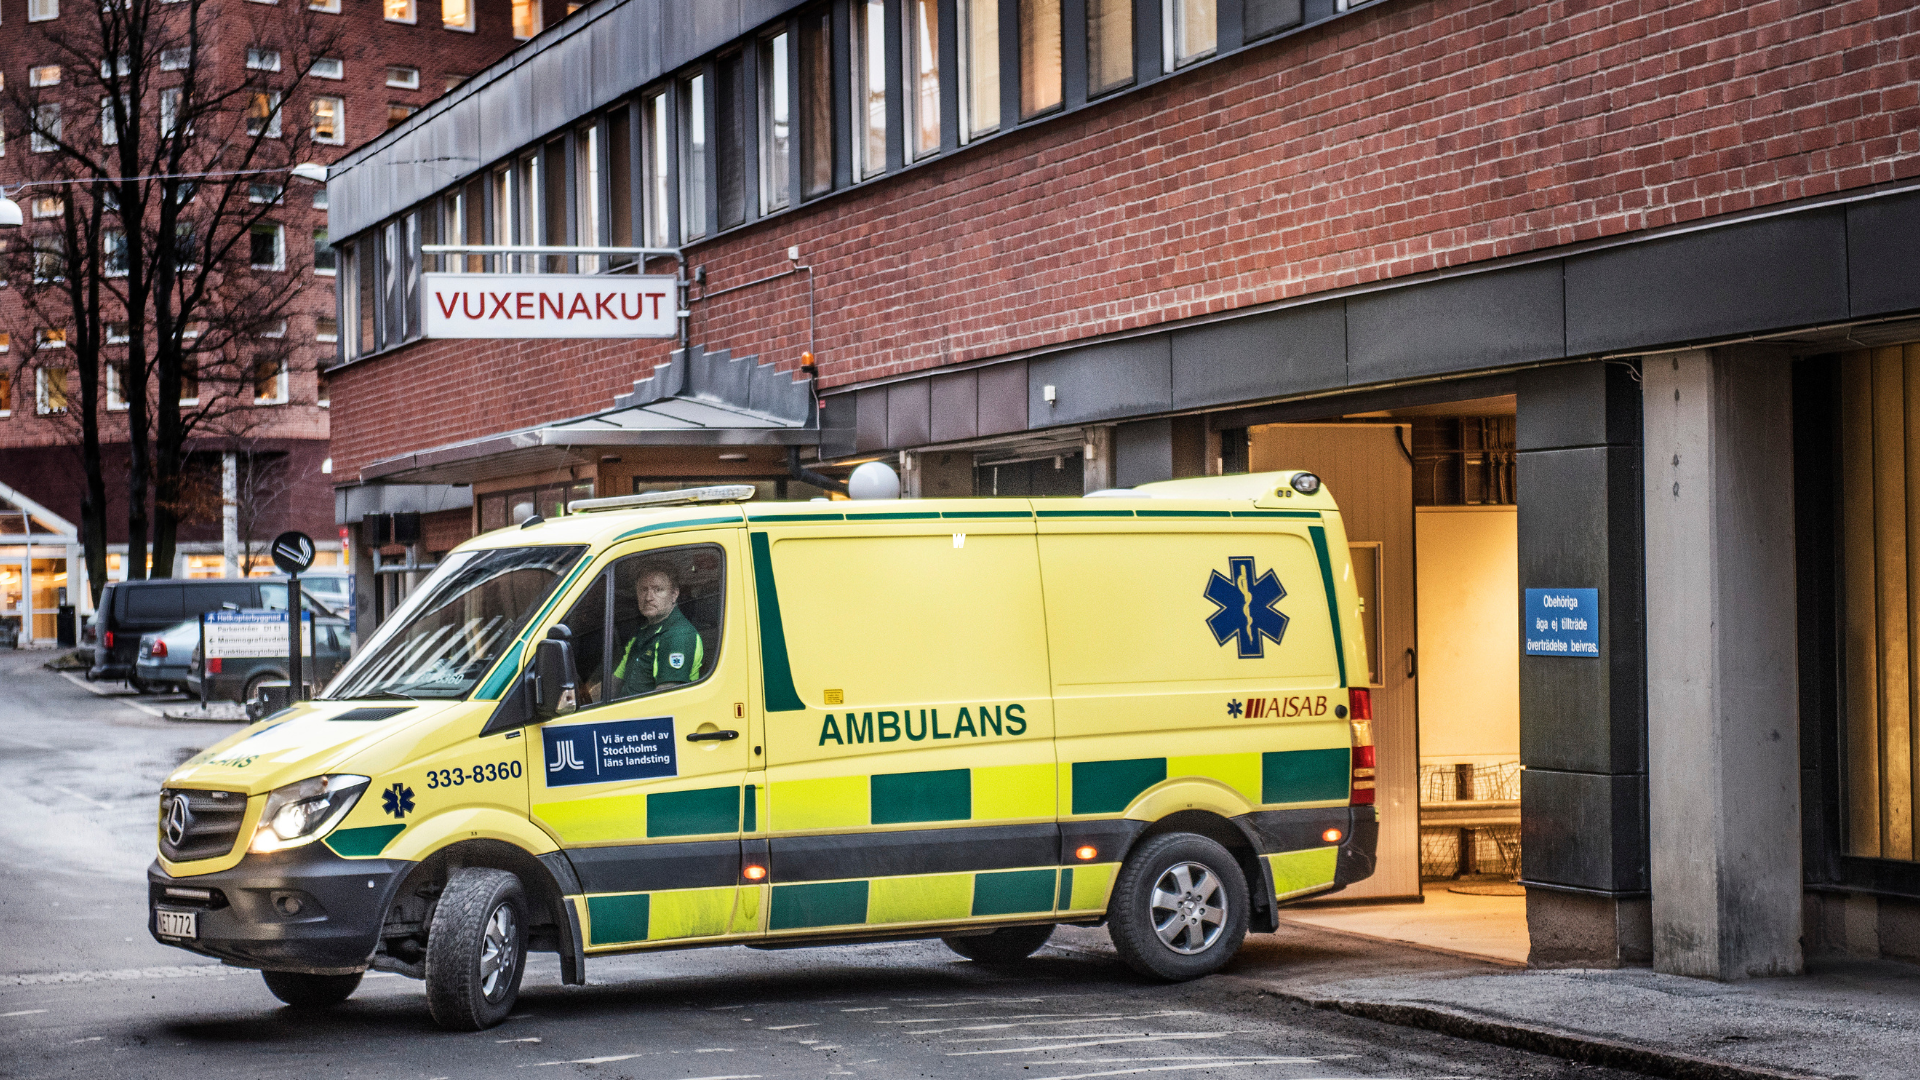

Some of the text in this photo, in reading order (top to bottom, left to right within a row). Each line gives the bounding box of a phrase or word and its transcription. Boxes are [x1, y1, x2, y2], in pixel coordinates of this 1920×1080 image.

[436, 292, 666, 320] VUXENAKUT
[1543, 594, 1578, 611] Obehöriga
[1536, 617, 1588, 632] äga ej tillträde
[218, 637, 288, 645] Mammografiavdeln
[1527, 638, 1599, 653] överträdelse beivras.
[1265, 695, 1328, 718] AISAB
[818, 703, 1028, 747] AMBULANS
[601, 731, 670, 744] Vi är en del av
[602, 743, 658, 756] Stockholms
[603, 754, 670, 768] läns landsting
[426, 760, 523, 789] 333-8360
[172, 914, 191, 935] 772
